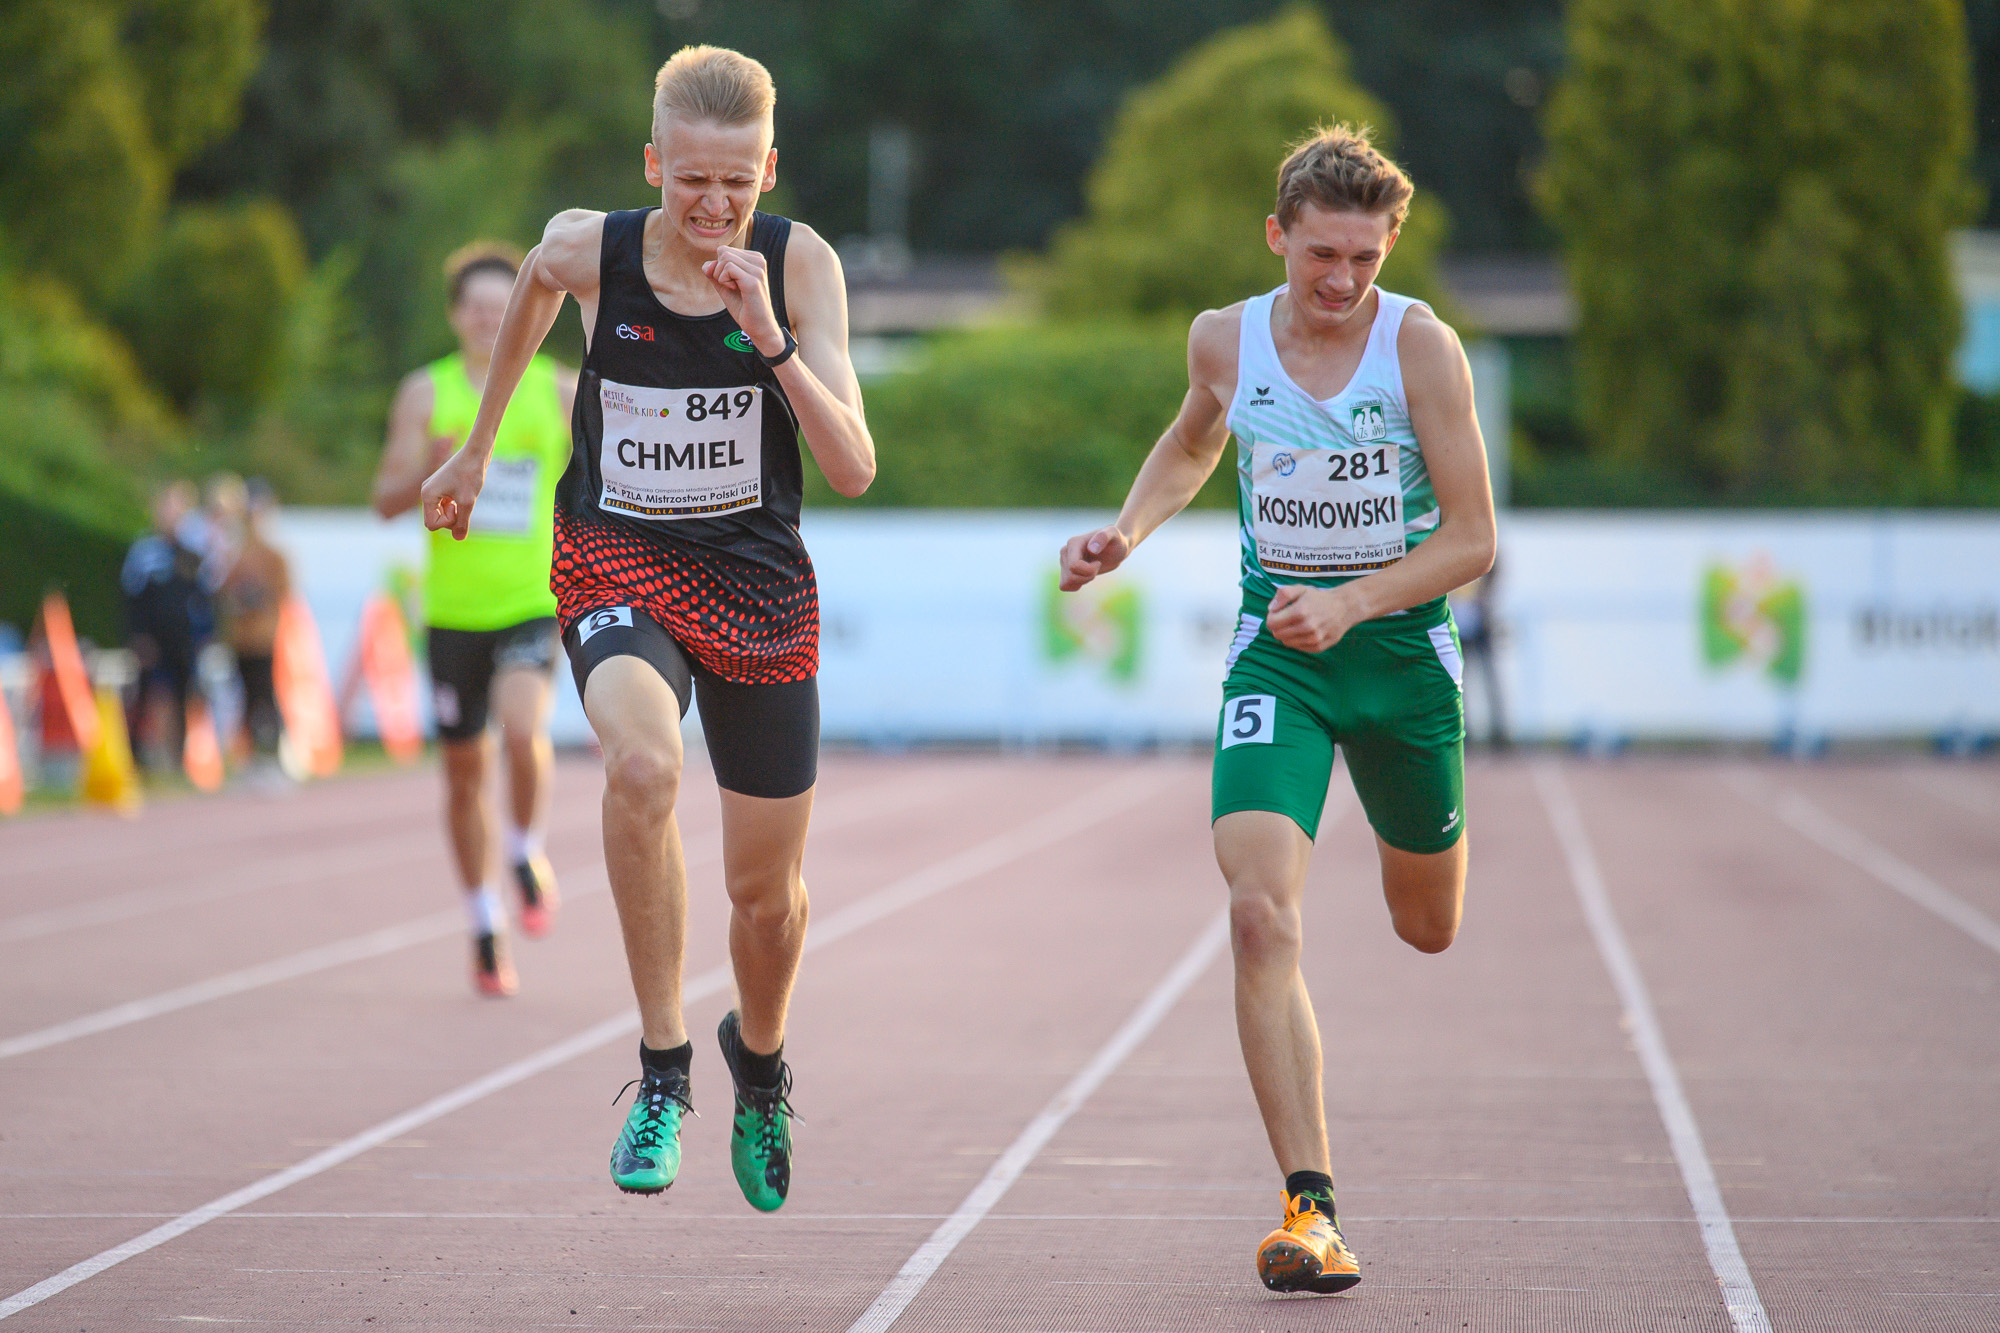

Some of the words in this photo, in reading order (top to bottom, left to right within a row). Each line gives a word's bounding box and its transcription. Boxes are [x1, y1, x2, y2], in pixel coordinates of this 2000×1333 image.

[641, 407, 658, 418] KIDS
[685, 390, 754, 422] 849
[617, 438, 745, 471] CHMIEL
[1328, 448, 1390, 482] 281
[606, 484, 620, 496] 54.
[621, 489, 643, 502] PZLA
[645, 494, 707, 504] Mistrzostwa
[710, 488, 739, 500] Polski
[741, 483, 759, 495] U18
[1258, 494, 1397, 529] KOSMOWSKI
[1271, 548, 1292, 559] PZLA
[1294, 552, 1352, 561] Mistrzostwa
[1354, 549, 1383, 559] Polski
[1385, 545, 1403, 556] U18
[589, 608, 620, 632] 6
[1232, 698, 1262, 739] 5
